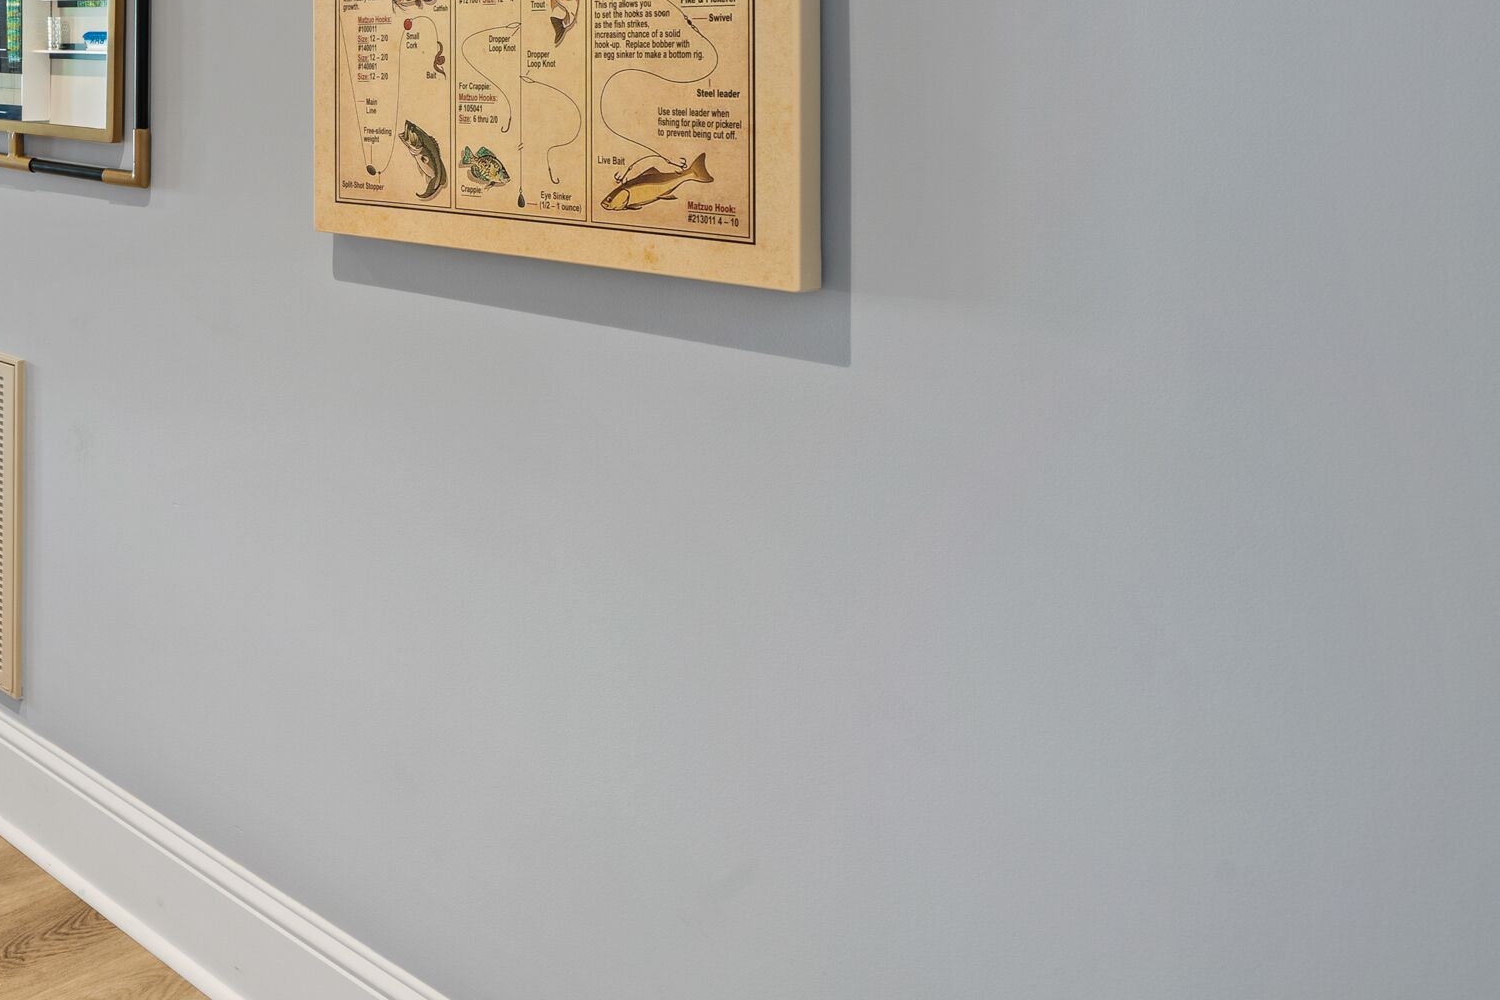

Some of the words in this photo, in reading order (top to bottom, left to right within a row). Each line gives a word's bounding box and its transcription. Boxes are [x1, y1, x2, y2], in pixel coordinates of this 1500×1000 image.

[595, 1, 607, 9] This
[619, 0, 638, 8] allows
[640, 1, 651, 9] you
[709, 14, 732, 22] Swivel
[489, 35, 510, 44] Dropper
[489, 45, 502, 53] Loop
[595, 42, 620, 50] hook-up.
[626, 41, 650, 50] Replace
[527, 51, 549, 59] Dropper
[527, 60, 541, 69] Loop
[697, 89, 715, 97] Steel
[717, 90, 740, 98] leader
[658, 108, 670, 116] Use
[672, 108, 688, 116] steel
[690, 109, 710, 117] leader
[712, 109, 729, 117] when
[658, 118, 679, 128] fishing
[681, 119, 690, 127] for
[692, 120, 705, 129] pike
[716, 120, 742, 130] pickerel
[667, 130, 691, 139] prevent
[693, 130, 711, 140] being
[713, 131, 724, 139] cut
[726, 131, 737, 139] off.
[688, 202, 713, 211] Matzuo
[715, 204, 735, 213] Hook:
